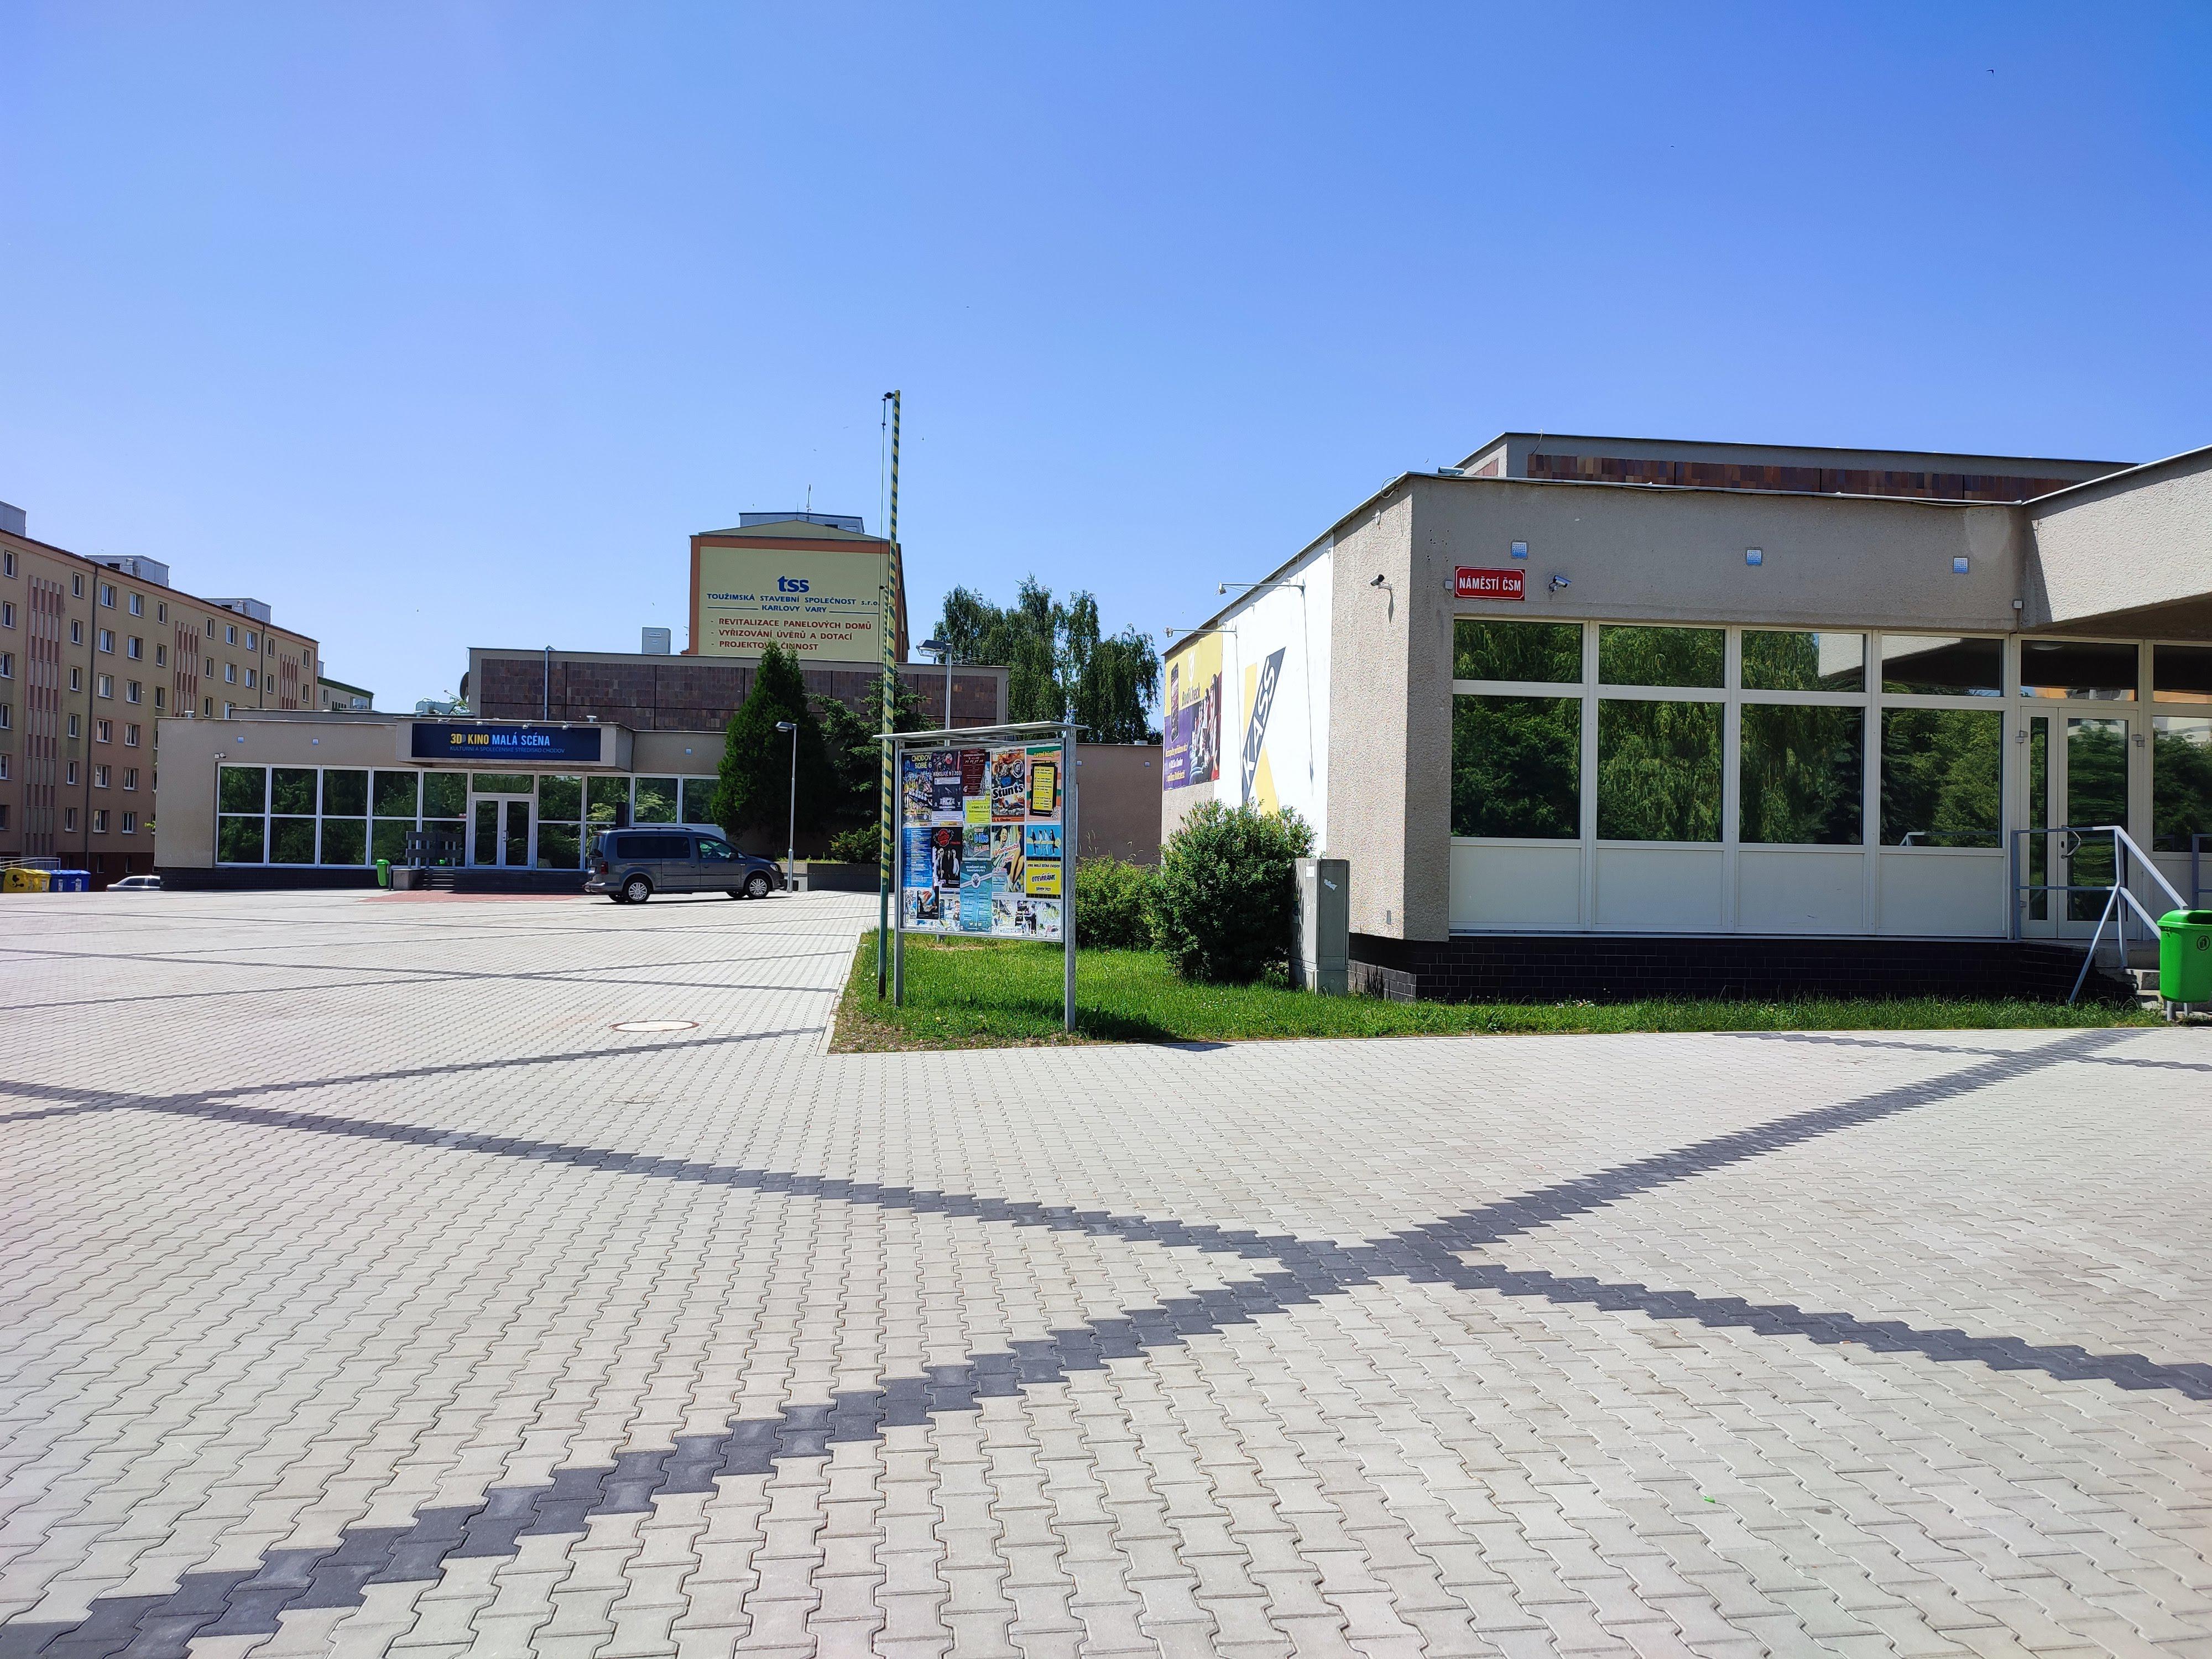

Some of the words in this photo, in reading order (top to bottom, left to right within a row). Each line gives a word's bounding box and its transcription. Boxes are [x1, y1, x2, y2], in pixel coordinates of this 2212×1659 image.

[777, 575, 810, 593] tss
[1459, 576, 1499, 589] NÁMĚSTÍ
[1503, 577, 1520, 591] ČSM
[707, 593, 755, 601] TOUŽIMSKÁ
[805, 597, 856, 605] SPOLEČNOST
[719, 618, 779, 627] REVITALIZACE
[784, 620, 841, 629] PANELOVÝCH
[846, 621, 872, 630] DOMŮ
[719, 629, 772, 638] VYŘIZOVÁNÍ
[777, 630, 805, 639] ÚVĚRŮ
[820, 632, 852, 640] DOTACÍ
[719, 641, 774, 649] PROJEKTOV
[781, 641, 818, 650] ČINNOST
[450, 733, 463, 744] 3D
[468, 734, 489, 745] KINO
[492, 732, 517, 745] MALÁ
[521, 732, 550, 745] SCÉNA
[993, 783, 1023, 799] Stunts
